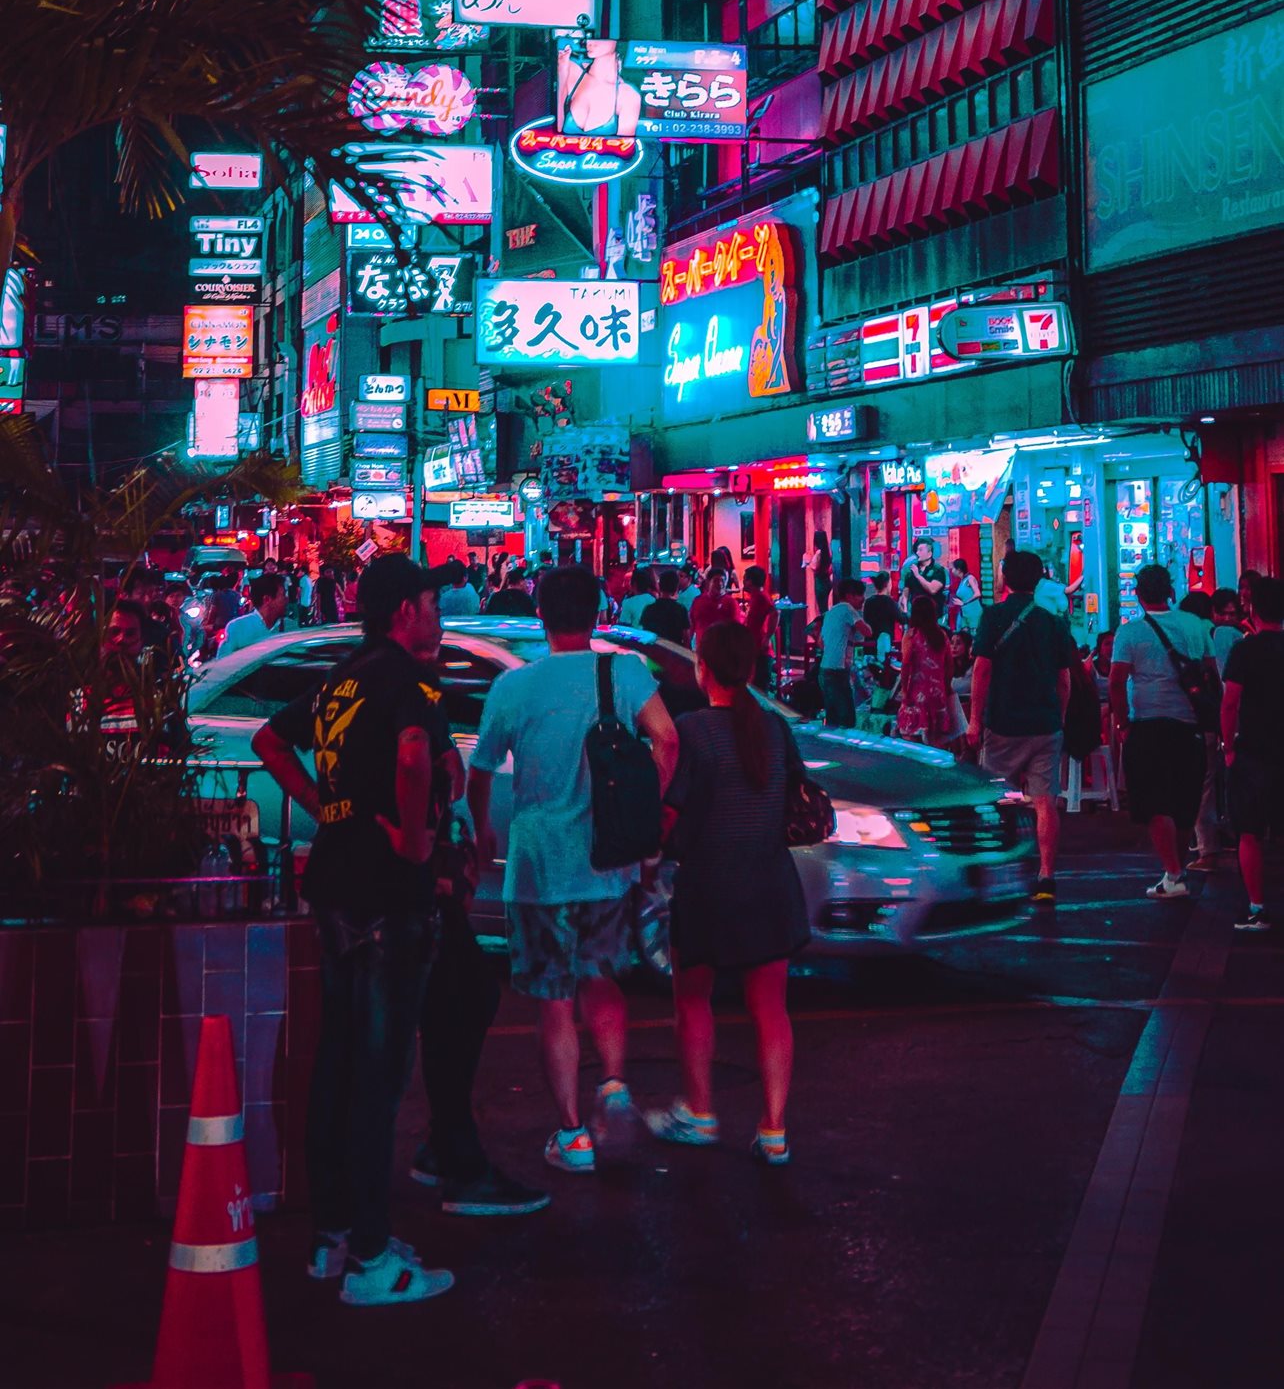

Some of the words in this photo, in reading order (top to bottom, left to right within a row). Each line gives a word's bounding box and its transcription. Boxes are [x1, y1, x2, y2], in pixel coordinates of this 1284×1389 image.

[640, 72, 742, 109] きらら
[663, 109, 687, 120] Club
[689, 110, 721, 120] Kirara
[644, 121, 663, 133] Tel
[672, 123, 742, 135] 02-238-3993
[536, 152, 577, 171] Super
[581, 152, 619, 170] Queen
[196, 232, 257, 258] Tiny
[486, 300, 632, 351] 多久味
[989, 324, 1015, 335] Smile
[188, 335, 249, 351] シナモン
[664, 322, 701, 403] Super
[703, 314, 744, 378] Queen
